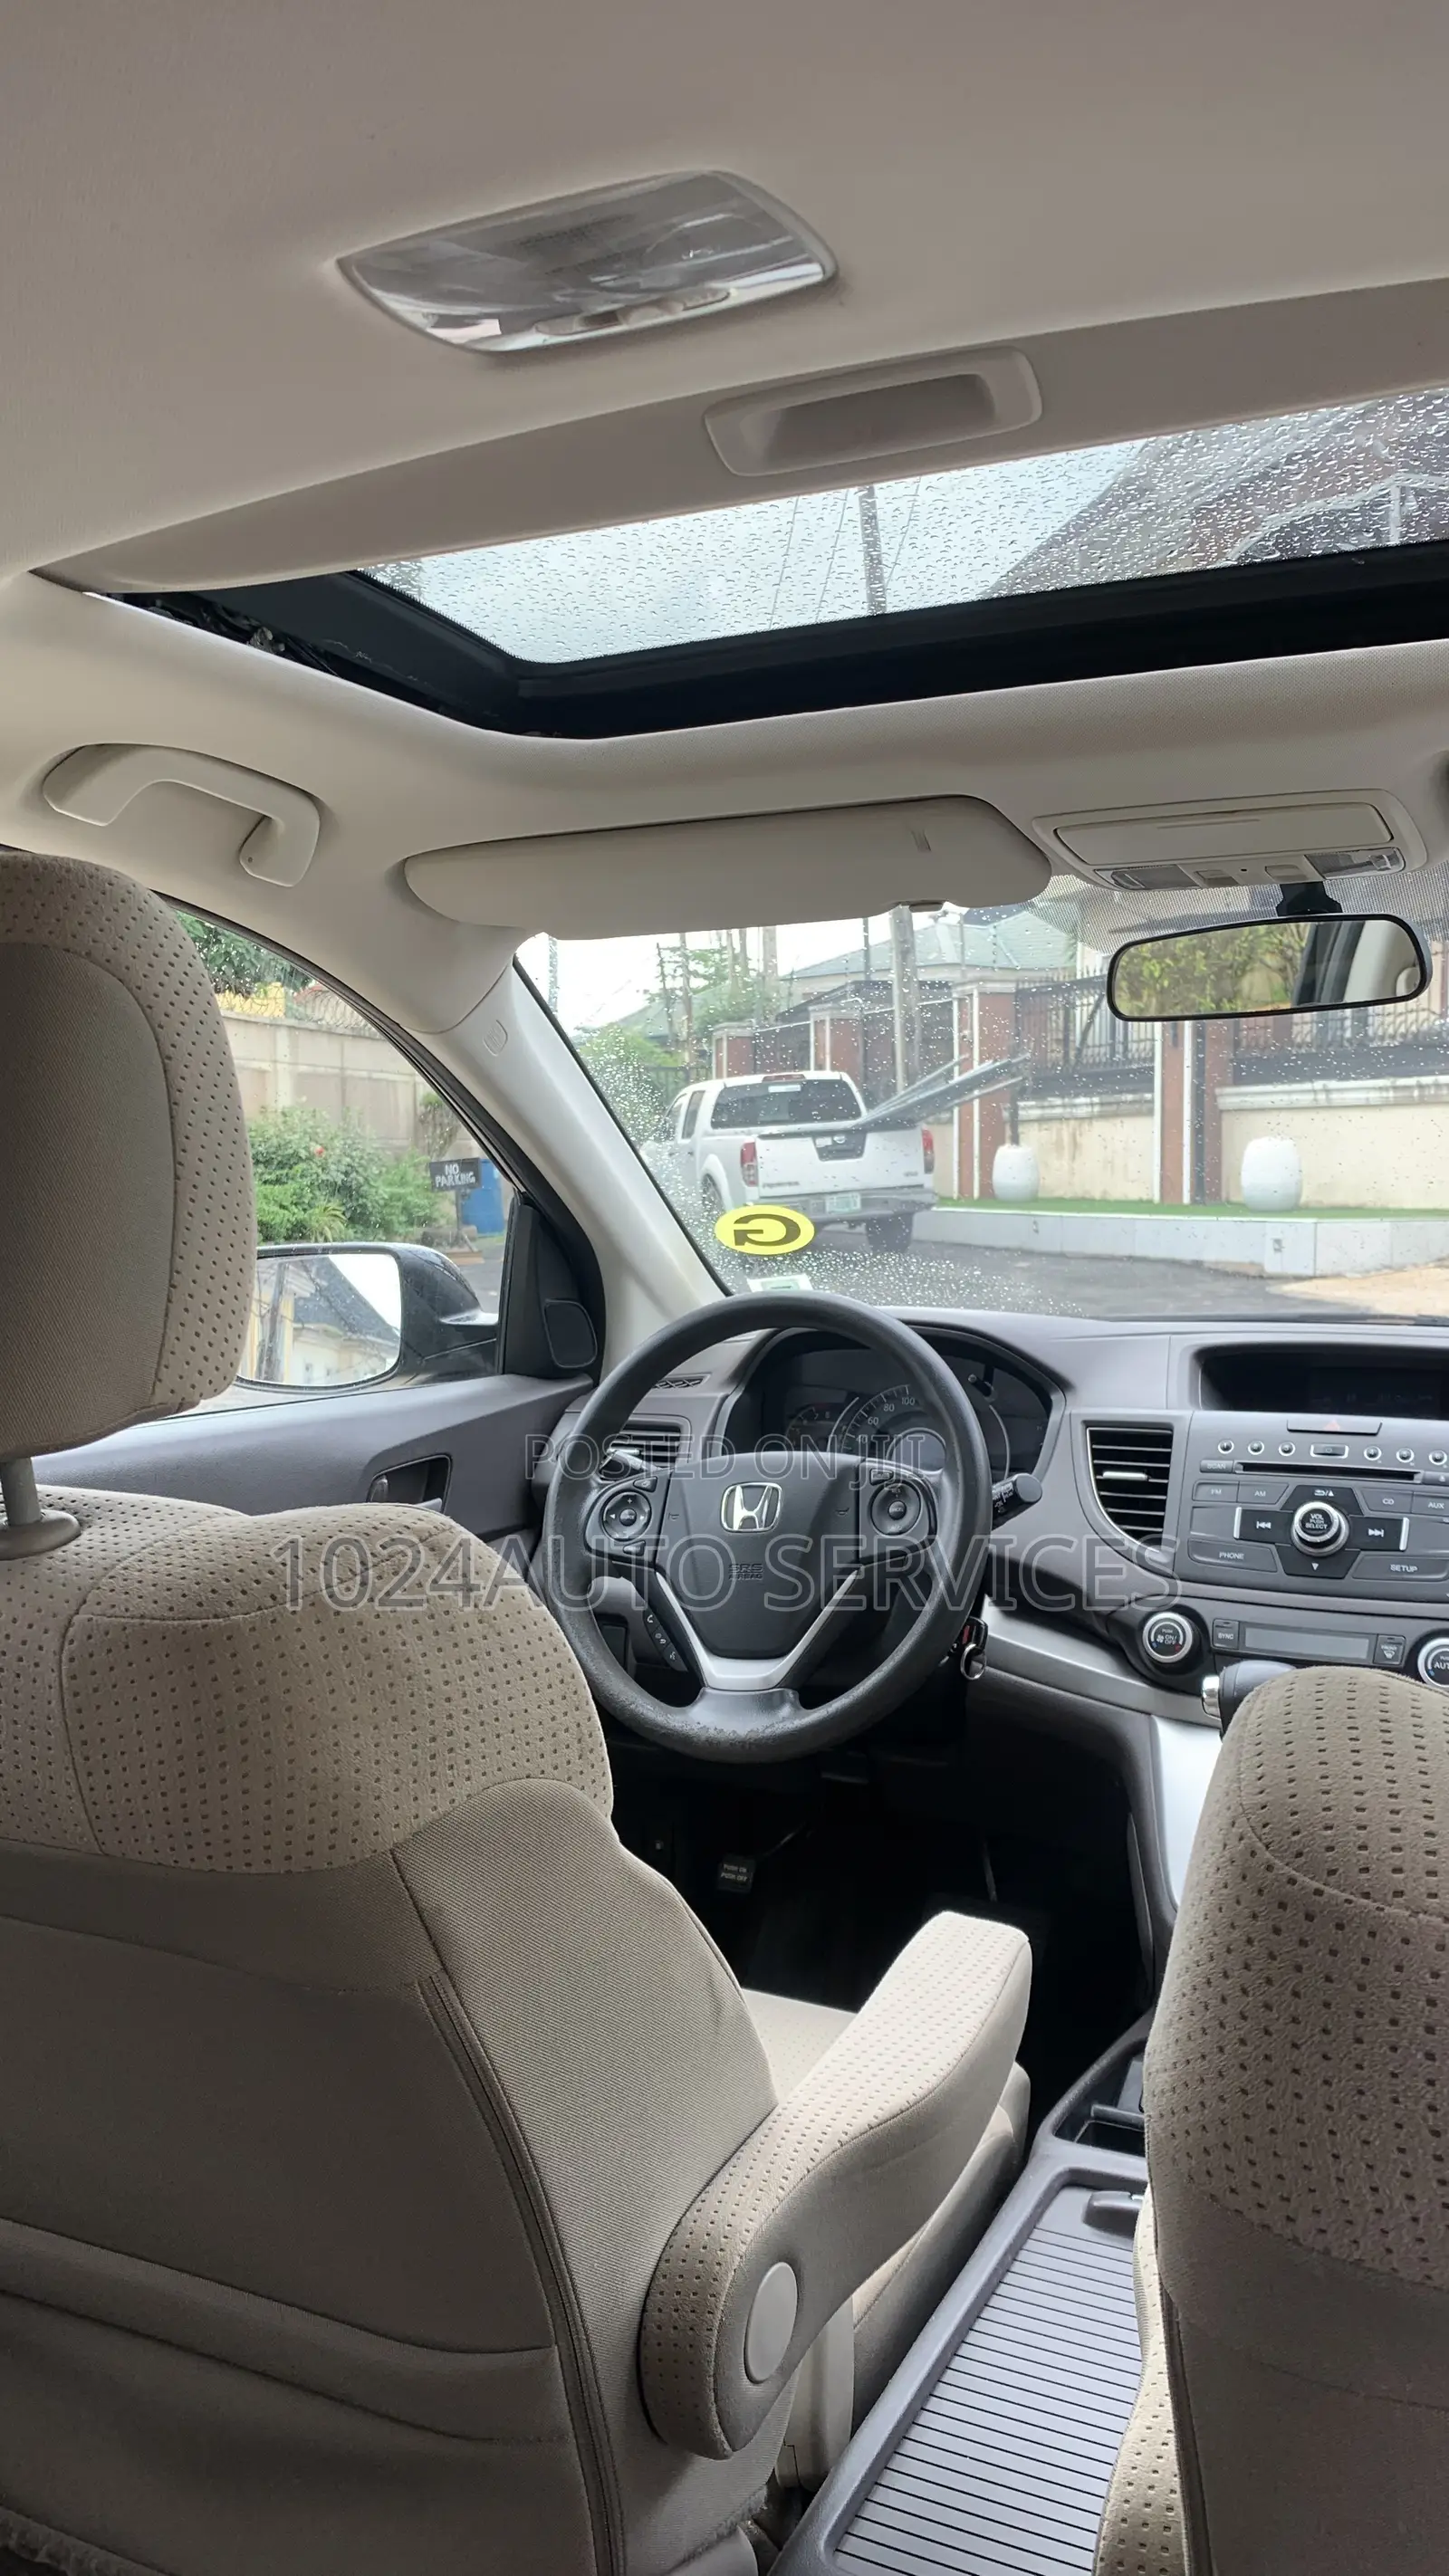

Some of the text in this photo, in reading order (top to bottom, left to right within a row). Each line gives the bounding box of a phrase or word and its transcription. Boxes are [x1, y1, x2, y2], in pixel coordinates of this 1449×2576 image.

[445, 1163, 459, 1175] NO
[436, 1171, 475, 1187] PARKING
[901, 1397, 916, 1406] 100
[883, 1403, 895, 1412] 80
[867, 1416, 879, 1425] 60
[1427, 1501, 1444, 1509] AUX
[1219, 1551, 1244, 1560] PHONE
[728, 1563, 763, 1574] SRS
[1390, 1564, 1418, 1573] SETUP
